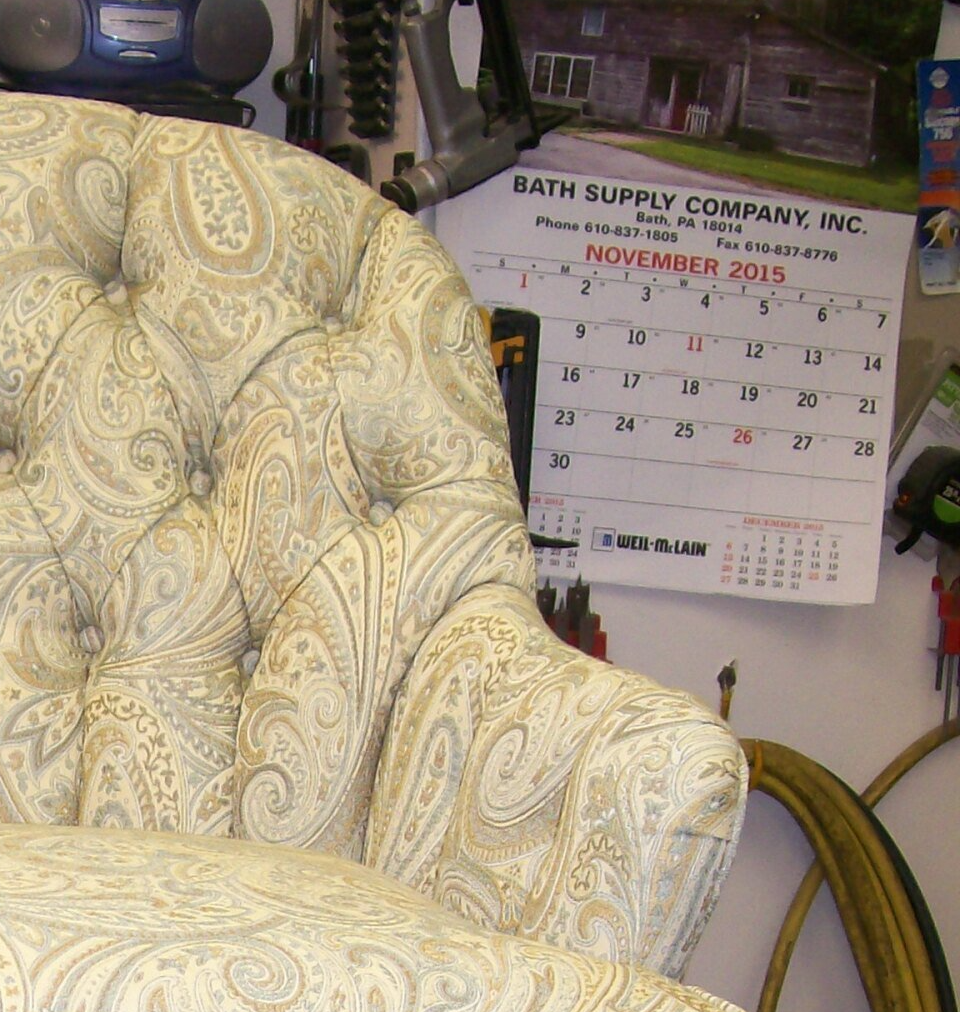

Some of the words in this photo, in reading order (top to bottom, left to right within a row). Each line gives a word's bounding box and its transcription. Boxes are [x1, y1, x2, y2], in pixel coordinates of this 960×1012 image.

[513, 175, 576, 199] BATH
[584, 184, 678, 212] SUPPLY
[685, 196, 810, 231] COMPANY,
[820, 212, 868, 235] INC.
[636, 211, 672, 227] Bath,
[677, 216, 696, 229] PA
[702, 219, 743, 234] 18014
[535, 216, 580, 232] Phone
[584, 222, 679, 243] 610-837-1805
[716, 237, 740, 251] Fax
[744, 241, 838, 262] 610-837-8776
[585, 243, 720, 276] NOVEMBER
[728, 260, 786, 284] 2015
[520, 273, 528, 288] 1
[580, 280, 591, 295] 2
[641, 286, 652, 302] 3
[700, 293, 710, 309] 4
[759, 300, 769, 315] 5
[817, 307, 827, 322] 6
[877, 313, 887, 329] 7
[575, 323, 586, 338] 9
[627, 329, 646, 345] 10
[687, 335, 703, 352] 11
[745, 342, 764, 359] 12
[804, 349, 822, 365] 13
[864, 355, 882, 372] 14
[562, 366, 581, 382] 16
[622, 373, 641, 389] 17
[681, 379, 700, 395] 18
[740, 385, 759, 402] 19
[797, 391, 818, 408] 20
[858, 398, 877, 415] 21
[554, 410, 575, 426] 23
[615, 416, 635, 432] 24
[674, 422, 694, 438] 25
[733, 428, 753, 445] 26
[792, 434, 813, 450] 27
[854, 440, 875, 456] 28
[549, 453, 570, 469] 30
